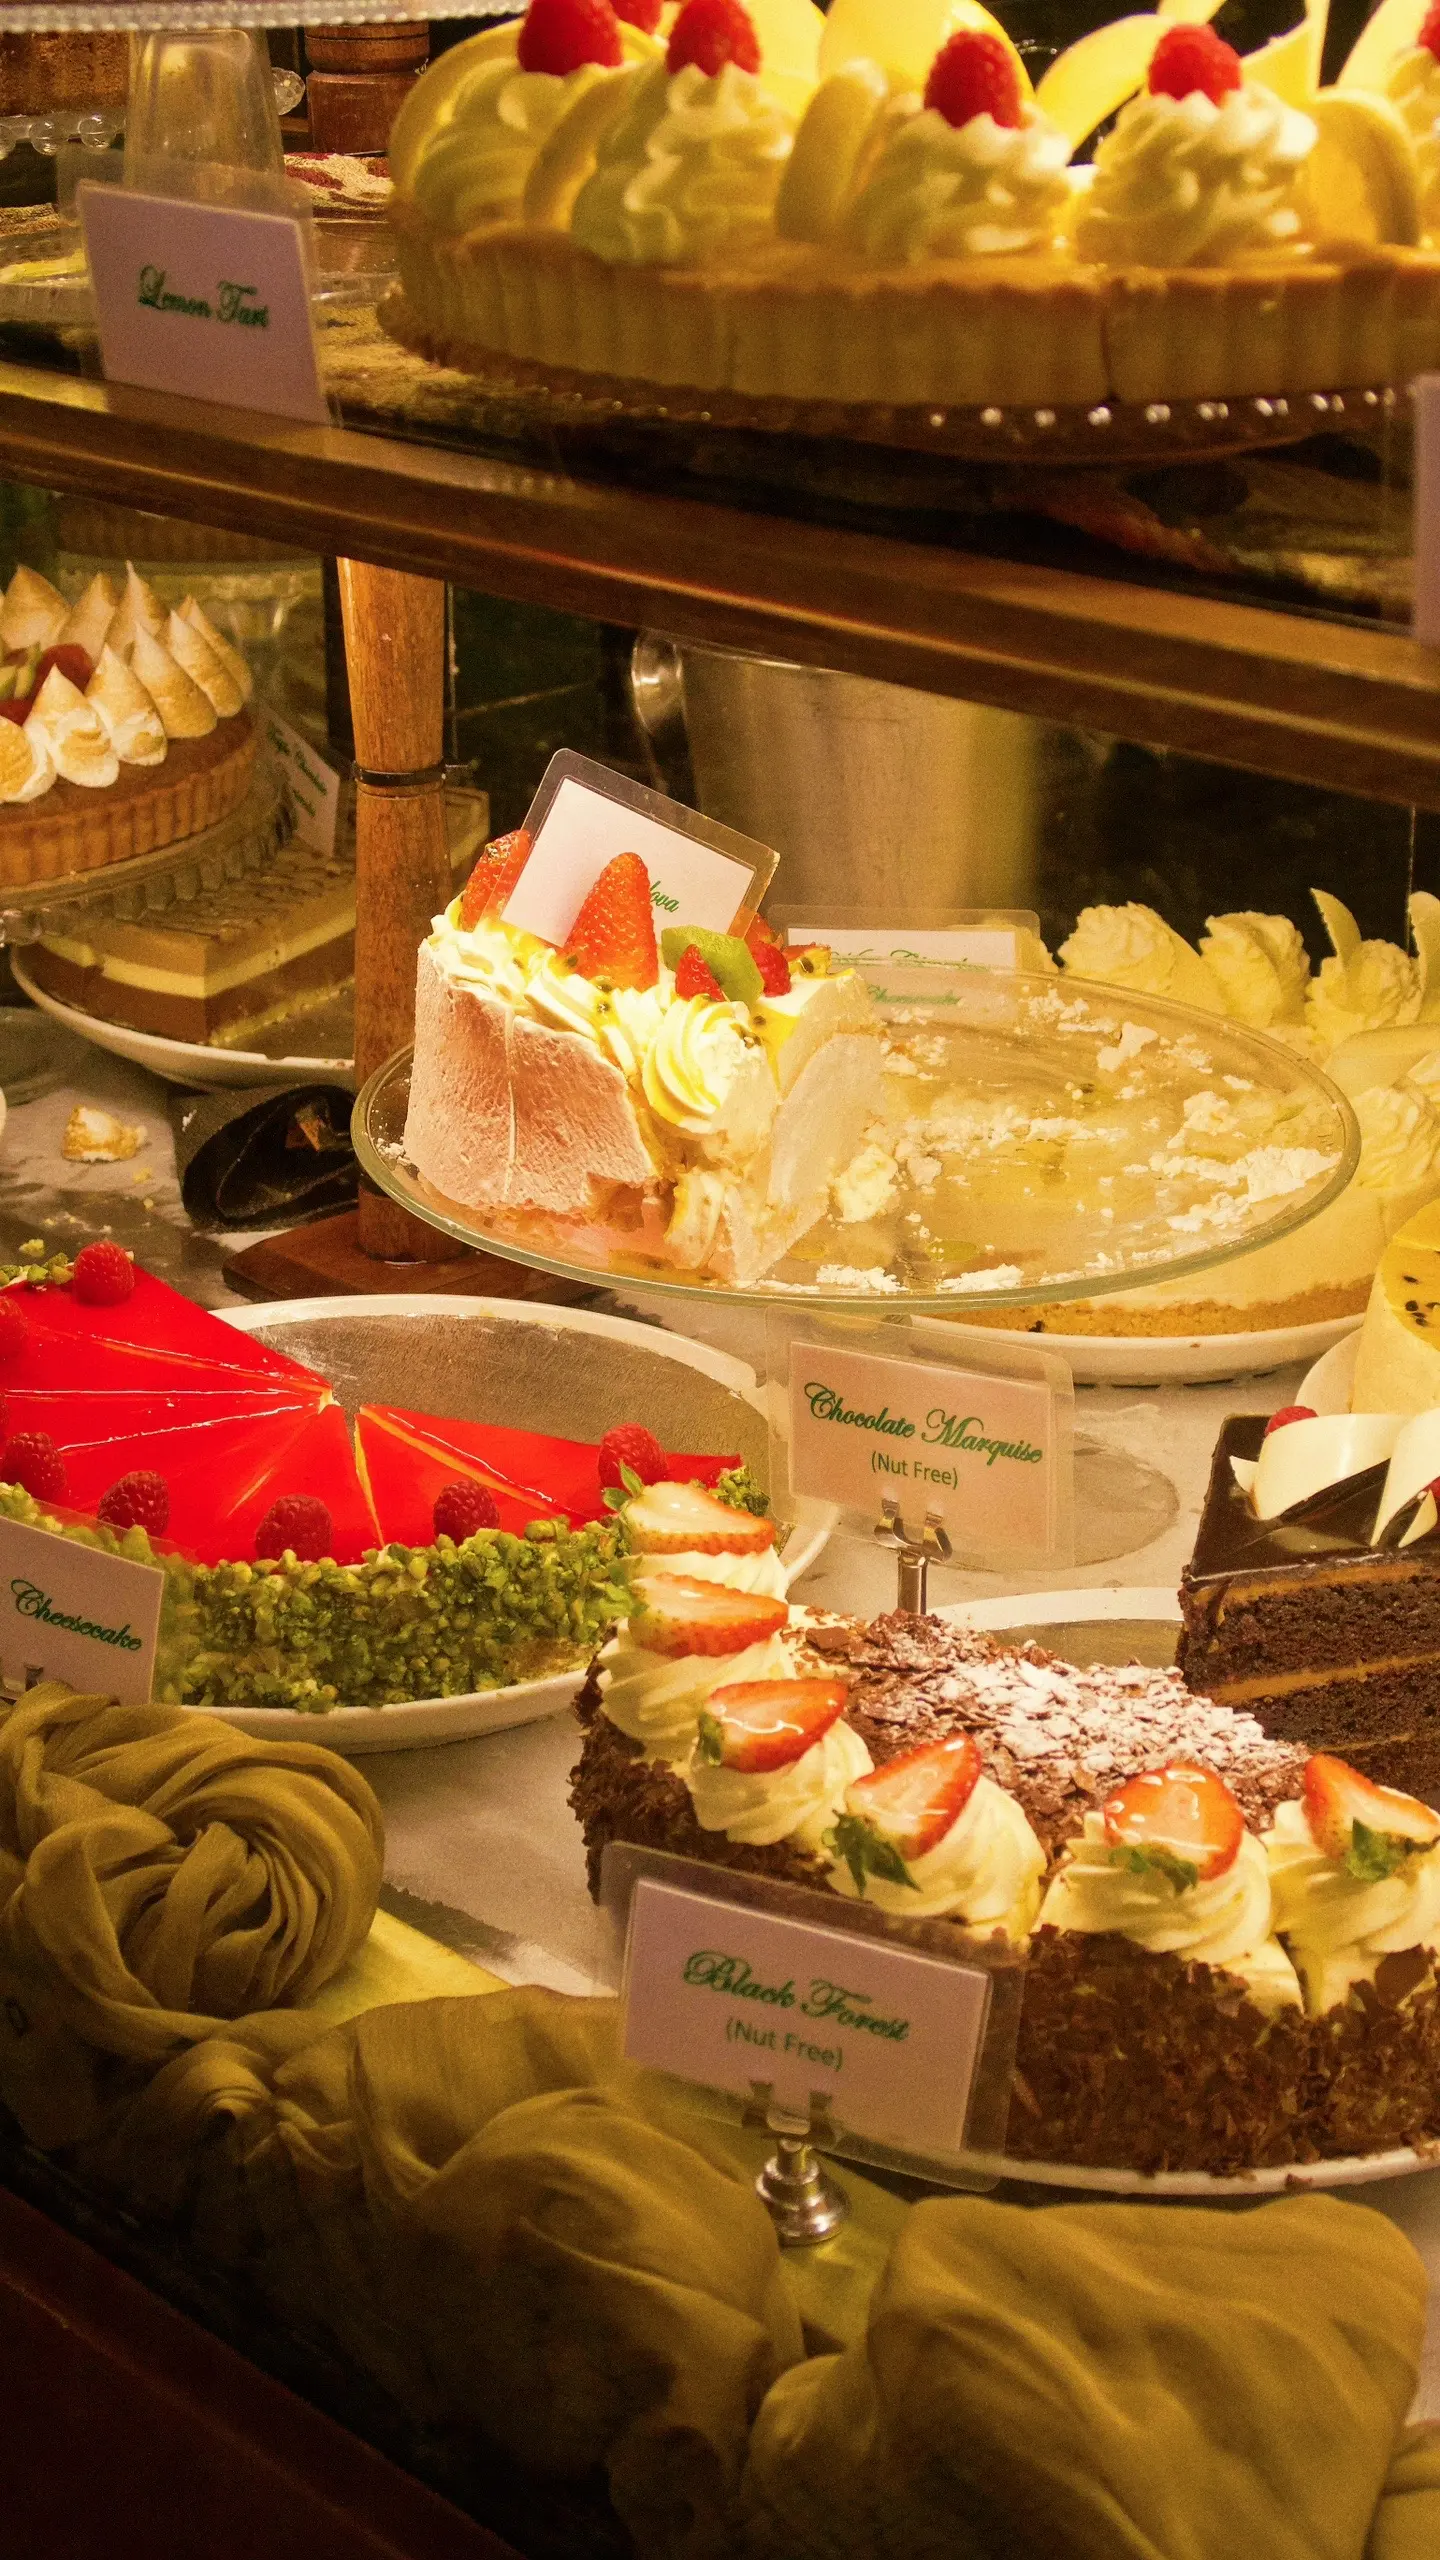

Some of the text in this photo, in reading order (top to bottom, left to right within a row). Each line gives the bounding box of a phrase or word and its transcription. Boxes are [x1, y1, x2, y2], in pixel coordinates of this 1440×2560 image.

[138, 265, 269, 328] Lemon Tart
[804, 1381, 1043, 1467] Chocolate Marquise
[871, 1450, 959, 1490] (Nut Free)
[10, 1579, 143, 1651] Cheesecake
[683, 1950, 911, 2042] Black Forest
[726, 2017, 844, 2073] (Nut Free)
